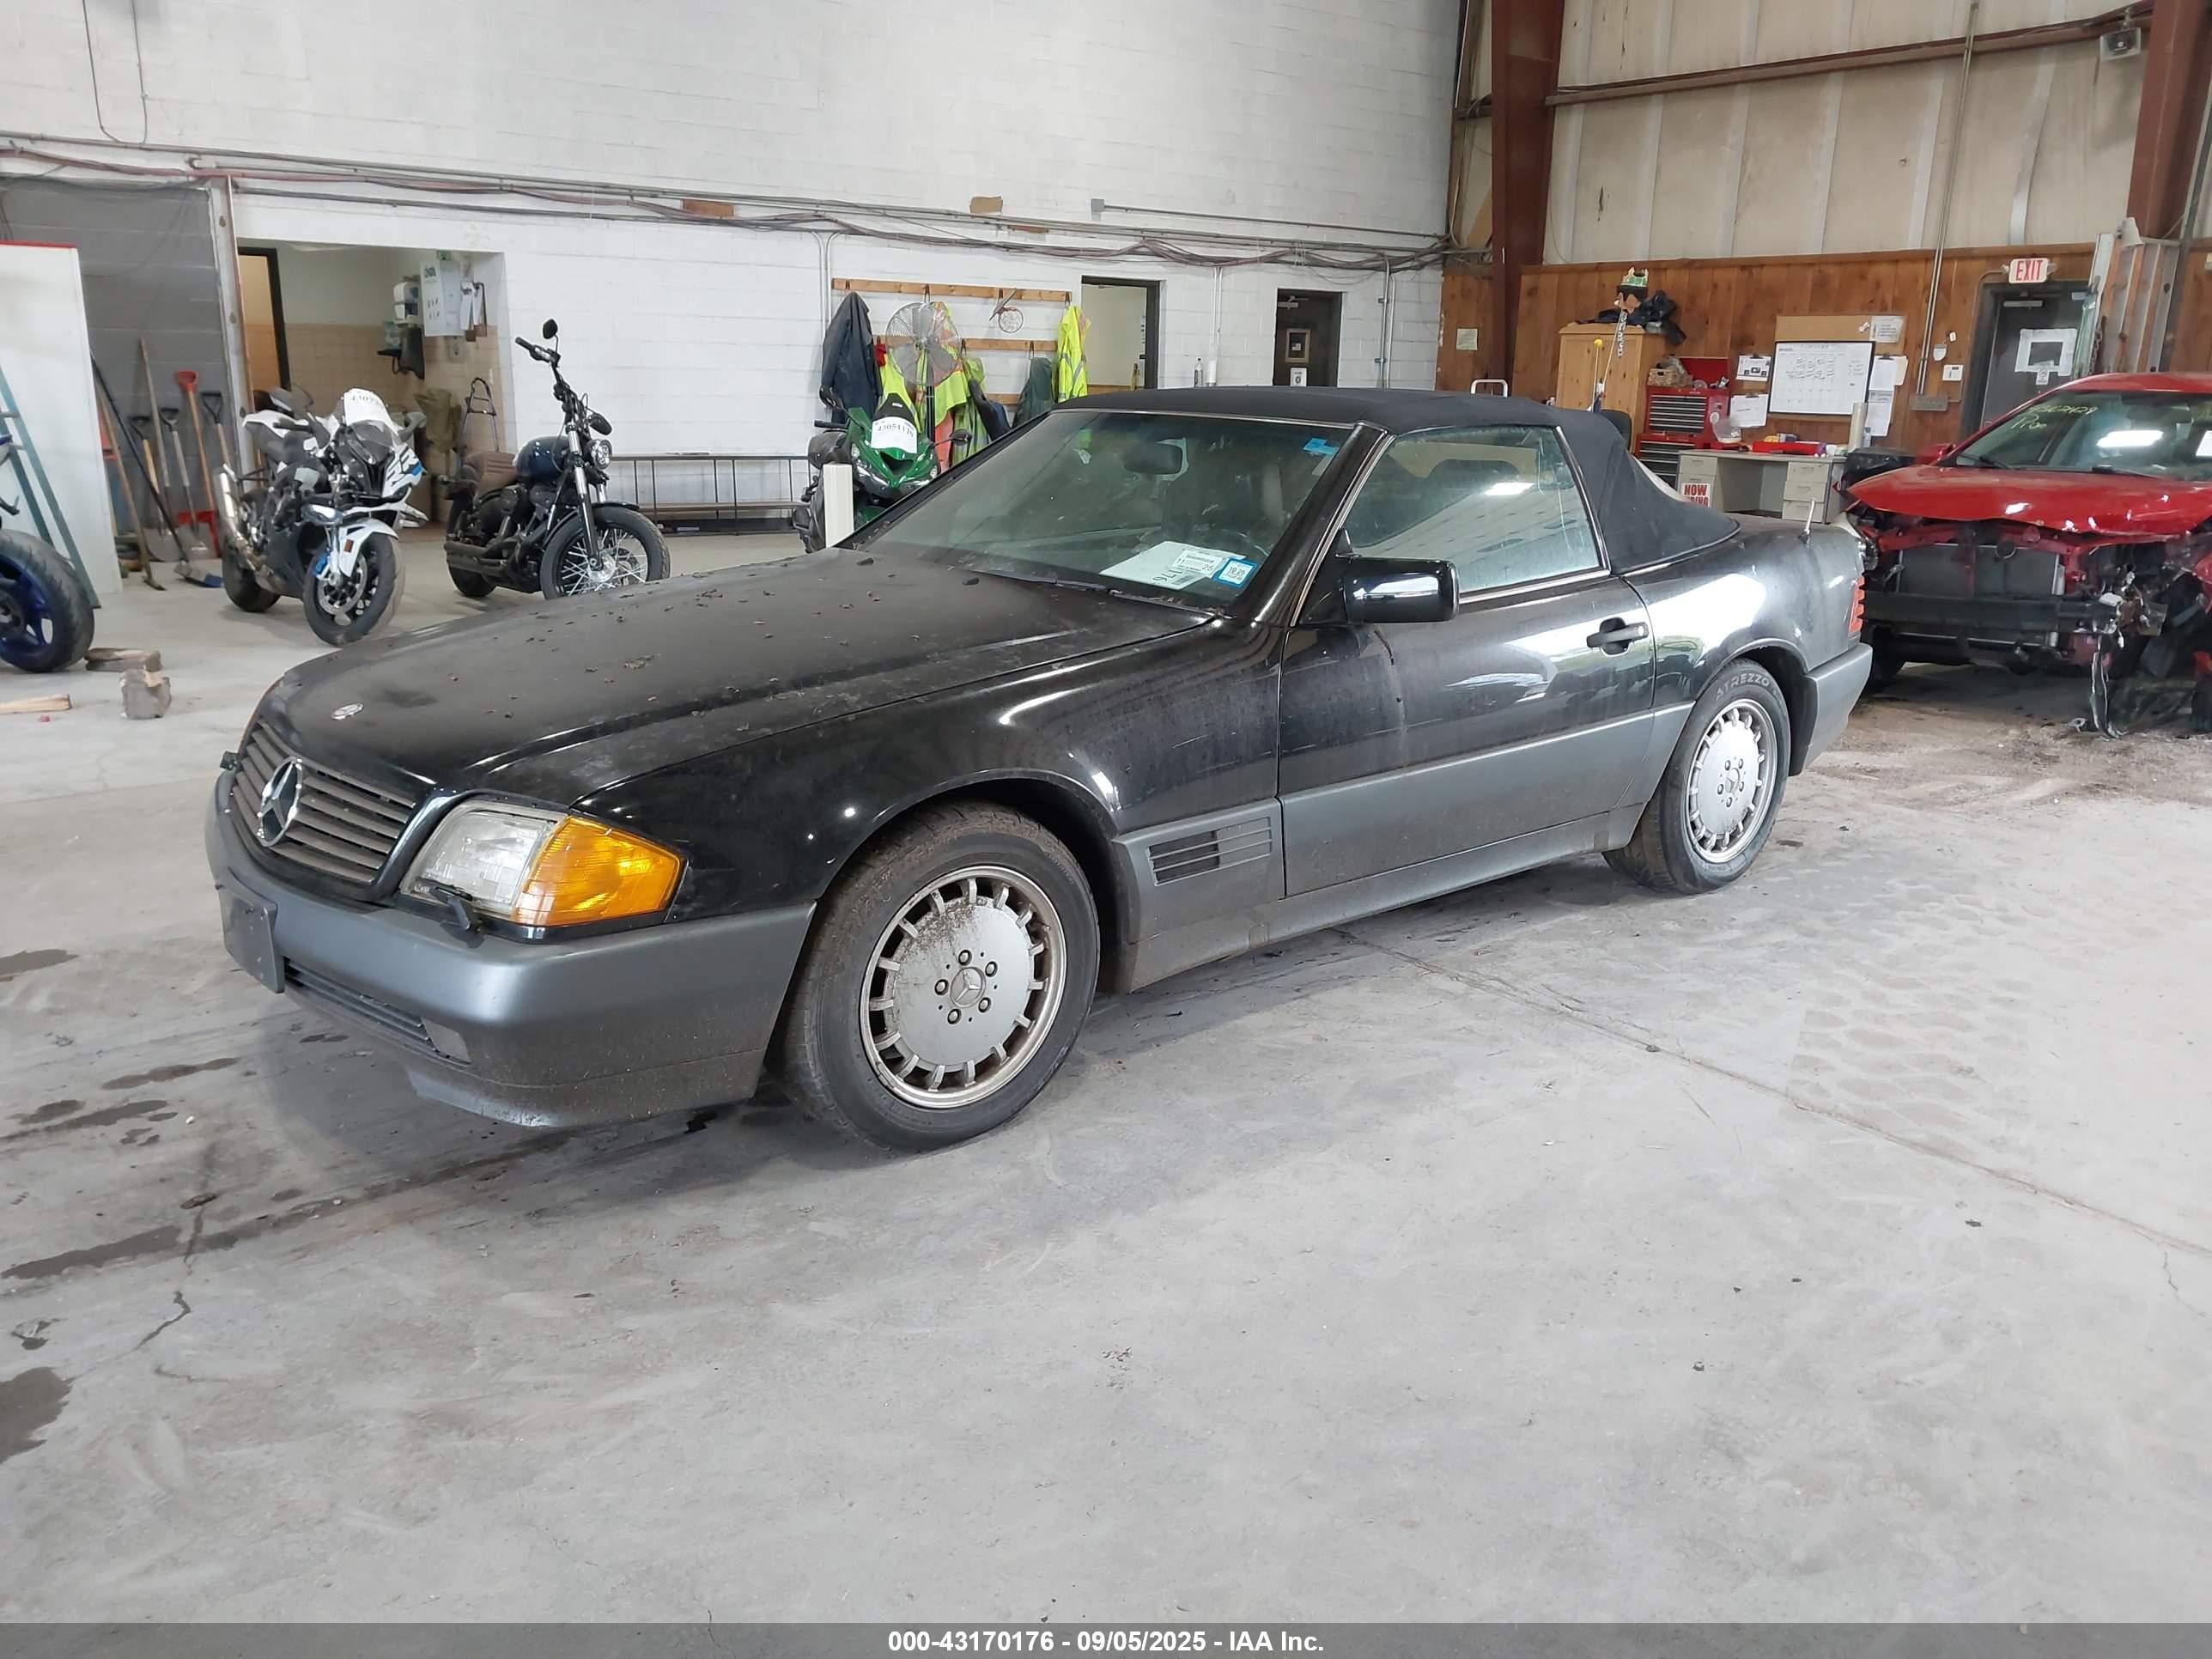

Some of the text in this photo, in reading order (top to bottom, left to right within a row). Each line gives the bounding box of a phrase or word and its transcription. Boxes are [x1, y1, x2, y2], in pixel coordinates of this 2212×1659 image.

[2015, 259, 2044, 282] EXIT
[1684, 483, 1708, 496] NOW
[1716, 672, 1771, 702] ATREZZO
